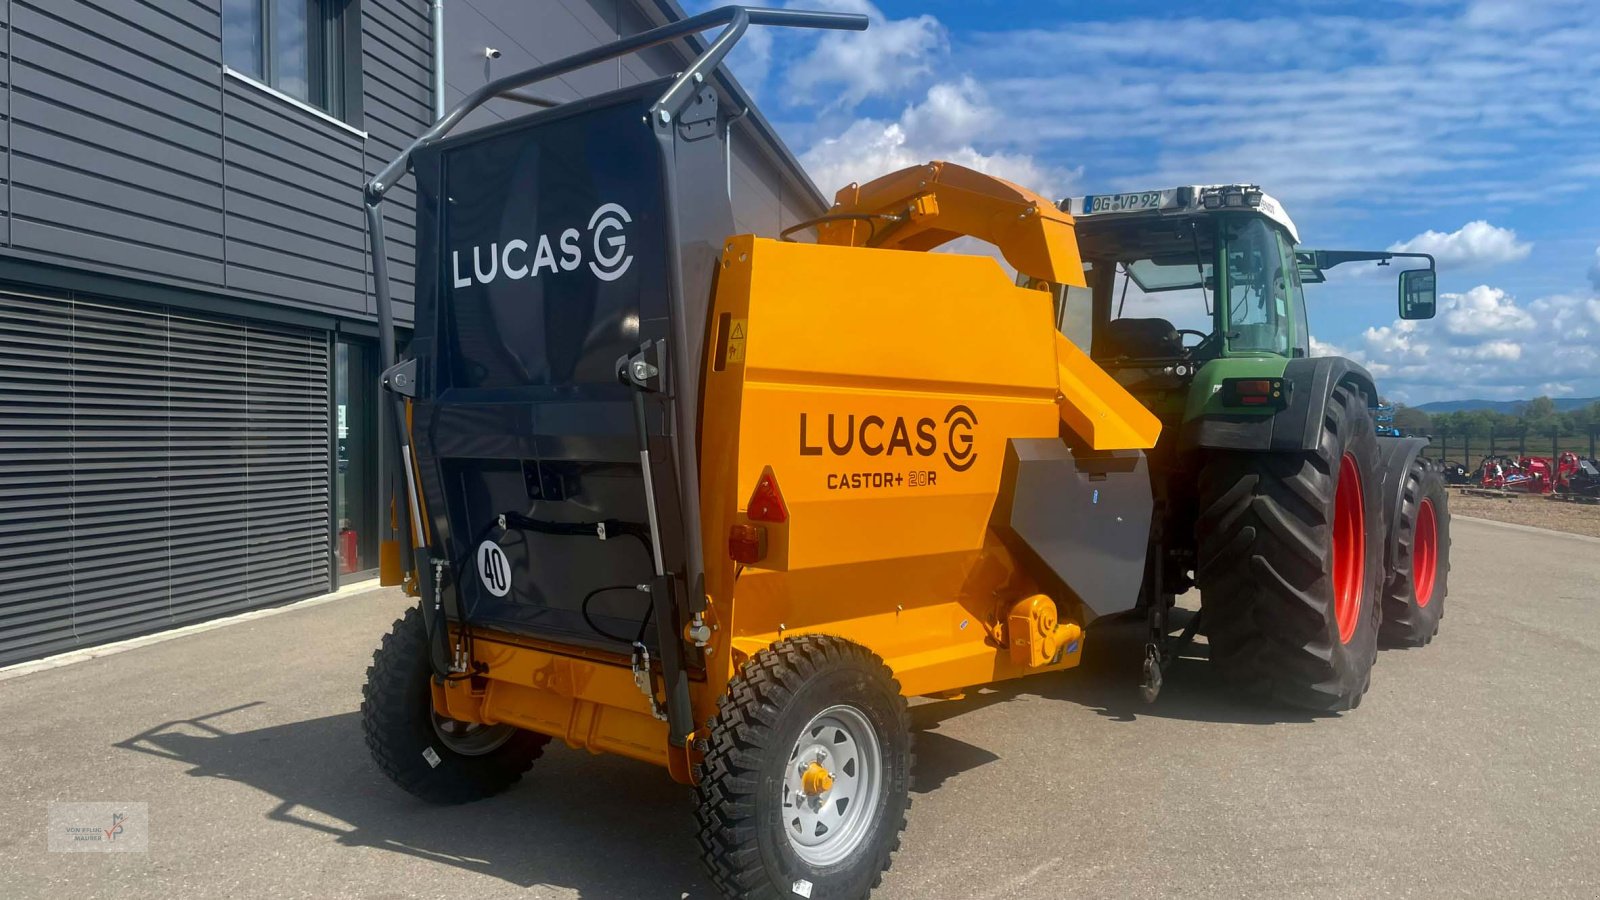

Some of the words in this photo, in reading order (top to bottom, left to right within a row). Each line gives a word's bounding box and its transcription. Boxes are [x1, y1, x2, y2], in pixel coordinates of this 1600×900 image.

[1093, 197, 1111, 211] OG
[1121, 195, 1139, 209] VP
[1141, 193, 1160, 208] 92
[453, 228, 582, 289] LUCAS
[800, 413, 937, 456] LUCAS
[827, 472, 903, 489] CASTOR+
[908, 471, 937, 487] 20R
[485, 548, 506, 591] 40
